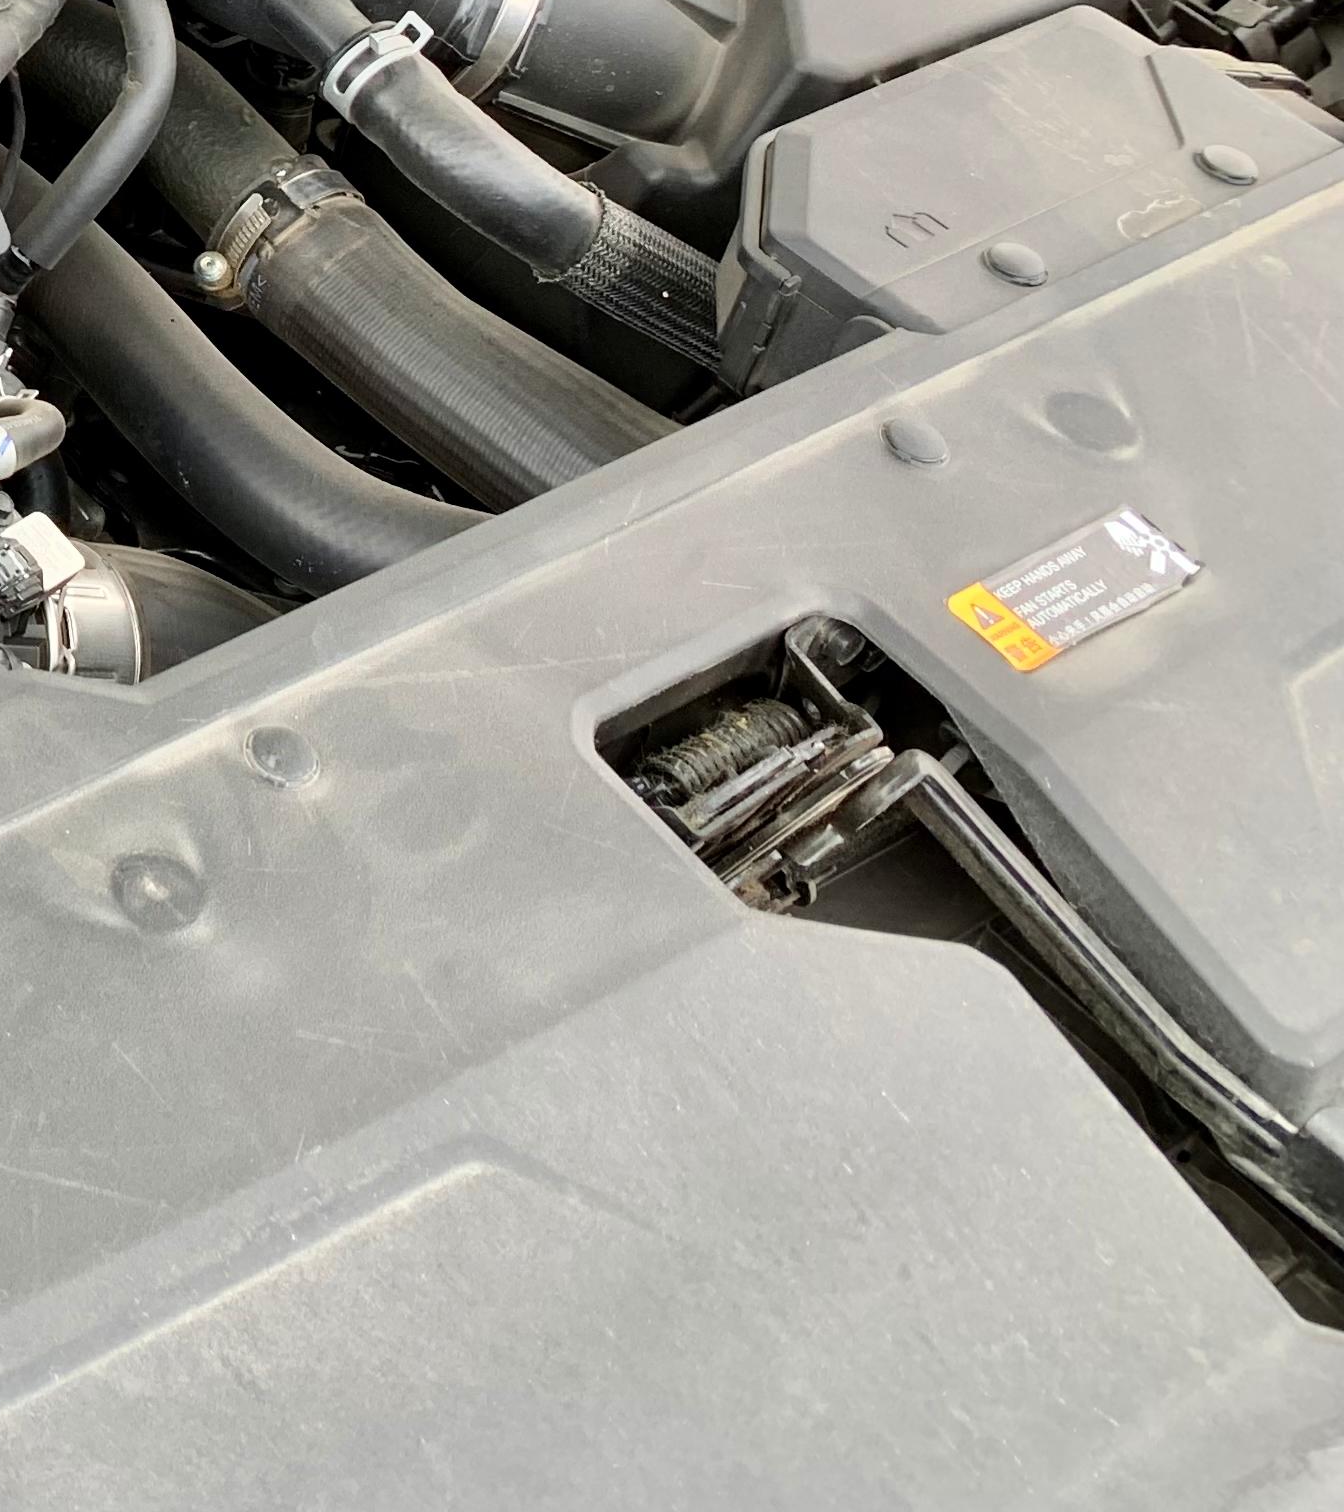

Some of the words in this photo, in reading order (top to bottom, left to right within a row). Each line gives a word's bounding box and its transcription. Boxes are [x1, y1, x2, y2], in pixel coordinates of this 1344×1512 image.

[993, 581, 1023, 601] KEEP
[1021, 559, 1061, 591] HANDS
[1057, 545, 1088, 569] AWAY
[1013, 600, 1039, 619] FAN
[1036, 578, 1079, 608] STARTS
[1028, 578, 1109, 631] AUTOMATICALLY
